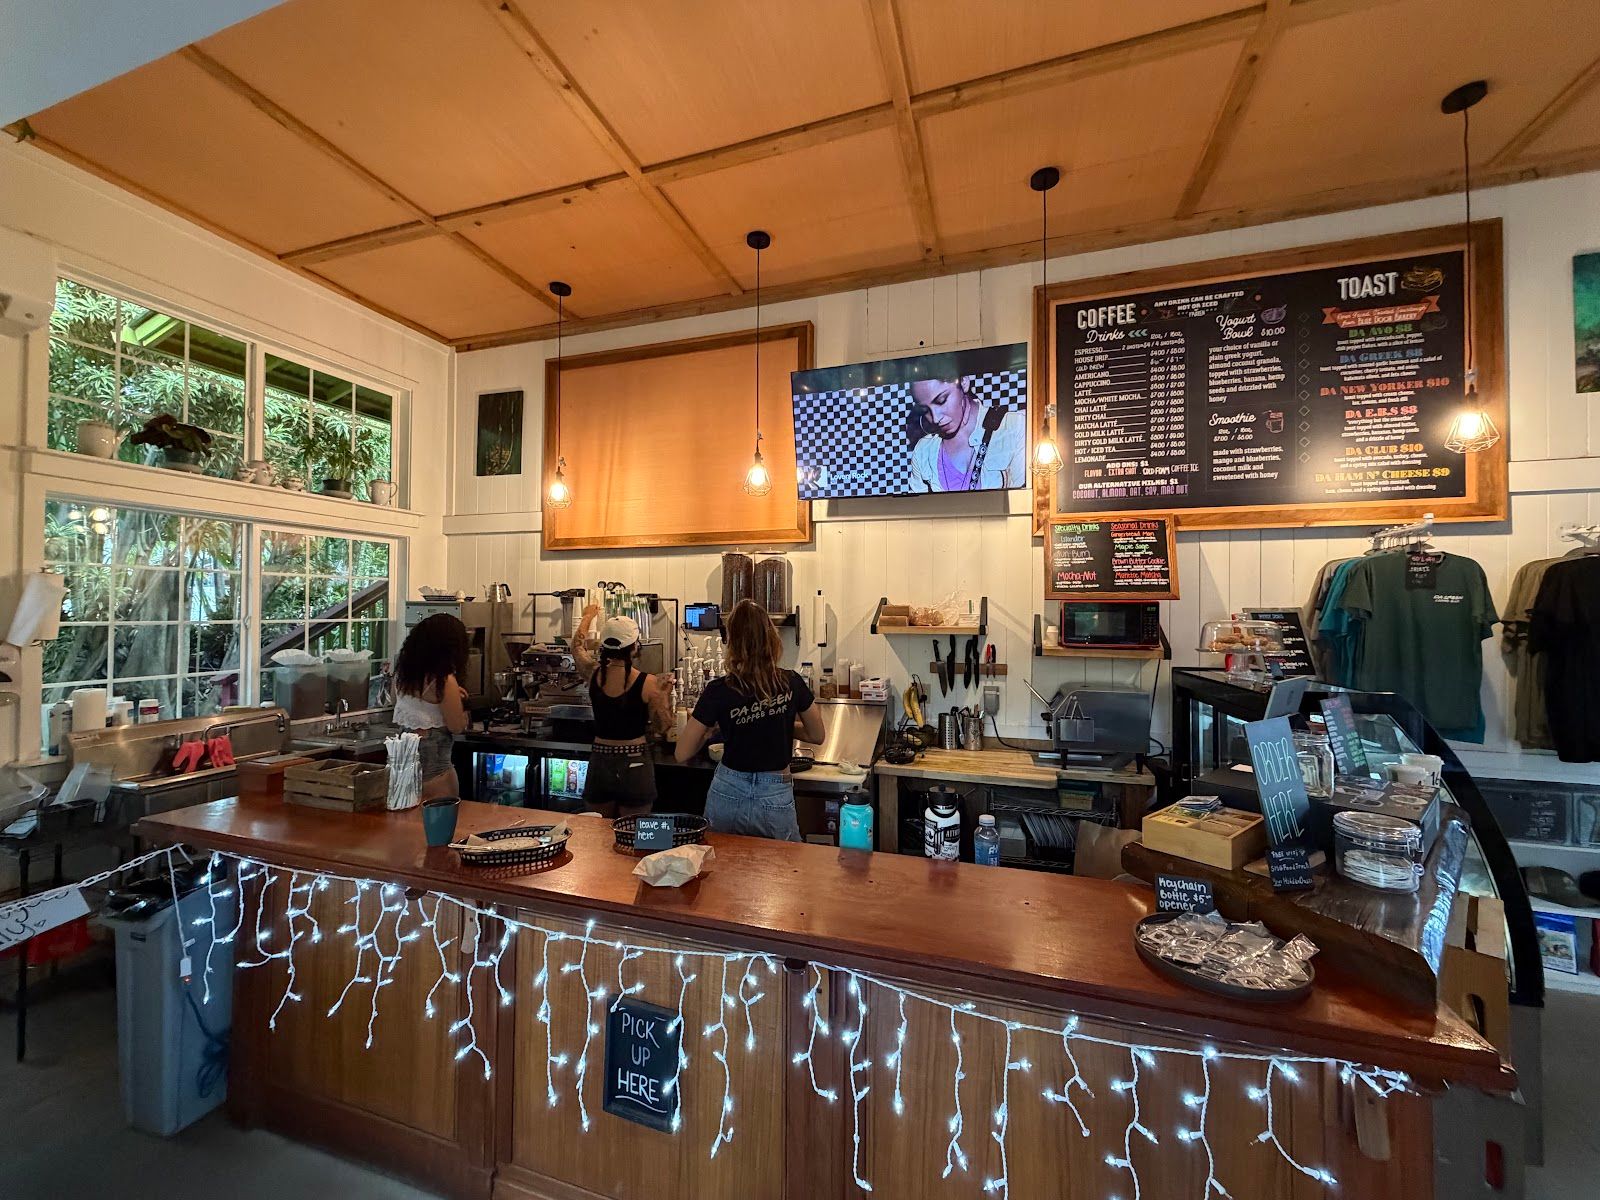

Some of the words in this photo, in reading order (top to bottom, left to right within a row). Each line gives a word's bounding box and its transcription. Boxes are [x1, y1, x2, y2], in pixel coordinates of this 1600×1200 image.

[1337, 272, 1398, 300] TOAST
[1168, 298, 1190, 306] DRINK
[1214, 290, 1244, 299] CRAFTED
[1078, 303, 1136, 329] COFFEE
[1216, 313, 1256, 331] Yogurt
[1085, 328, 1125, 344] Drinks
[1222, 326, 1254, 340] Bowl
[1348, 329, 1365, 338] DA
[1370, 326, 1393, 336] AVO
[1074, 346, 1103, 356] ESPRESSO
[1208, 346, 1222, 354] your
[1223, 344, 1242, 352] choice
[1250, 340, 1270, 348] vanilla
[1074, 356, 1094, 364] HOUSE
[1094, 354, 1108, 362] DRIP
[1208, 354, 1224, 362] plain
[1224, 352, 1242, 360] greek
[1340, 354, 1356, 364] DA
[1359, 351, 1402, 362] GREEK
[1208, 362, 1230, 370] almond
[1074, 371, 1110, 380] AMERICANO
[1208, 370, 1228, 378] topped
[1074, 380, 1110, 388] CAPPUCCINO
[1238, 384, 1262, 392] drizzled
[1320, 387, 1336, 396] DA
[1340, 384, 1366, 394] NEW
[1370, 380, 1424, 392] YORKER
[1427, 378, 1450, 387] $10
[1074, 395, 1118, 406] MOCHA/WHITE
[1119, 394, 1141, 402] MOCHA
[1208, 395, 1227, 403] honey
[1074, 406, 1088, 414] CHAI
[1345, 410, 1362, 418] DA
[1400, 405, 1418, 414] $8
[1074, 414, 1092, 422] DIRTY
[1092, 412, 1107, 420] CHAI
[1209, 412, 1256, 426] Smoothie
[1074, 422, 1099, 430] MATCHA
[1092, 438, 1108, 446] GOLD
[1074, 448, 1086, 456] HOT
[1345, 447, 1362, 456] DA
[1365, 445, 1398, 454] CLUB
[1400, 444, 1424, 453] $10
[1074, 456, 1106, 464] LEMONADE
[1212, 458, 1233, 466] mango
[1108, 468, 1124, 476] EXTRA
[1125, 467, 1136, 475] SHOT
[1142, 467, 1154, 476] COLD
[1155, 466, 1170, 474] FOAM
[1170, 464, 1190, 472] COFFEE
[1190, 464, 1199, 472] ICE
[1316, 474, 1332, 482] DA
[1335, 472, 1363, 481] HAM
[1382, 468, 1430, 478] CHEESE
[1094, 480, 1141, 488] ALTERNATIVE
[1161, 485, 1174, 494] MAC
[1176, 484, 1188, 494] NUT
[1110, 522, 1138, 530] Seasonal
[1134, 544, 1150, 552] Sage
[1148, 556, 1166, 564] Cookie
[1057, 571, 1096, 580] Mocha-Nut
[730, 706, 749, 718] DA
[736, 710, 766, 724] COFFEE
[768, 704, 788, 716] BAR
[1253, 737, 1299, 786] ORDER
[1264, 789, 1305, 846] HERE
[639, 820, 660, 830] leave
[638, 830, 655, 840] here
[1159, 900, 1196, 911] opener
[622, 1012, 660, 1048] PICK
[632, 1044, 650, 1068] UP
[618, 1068, 660, 1104] HERE
